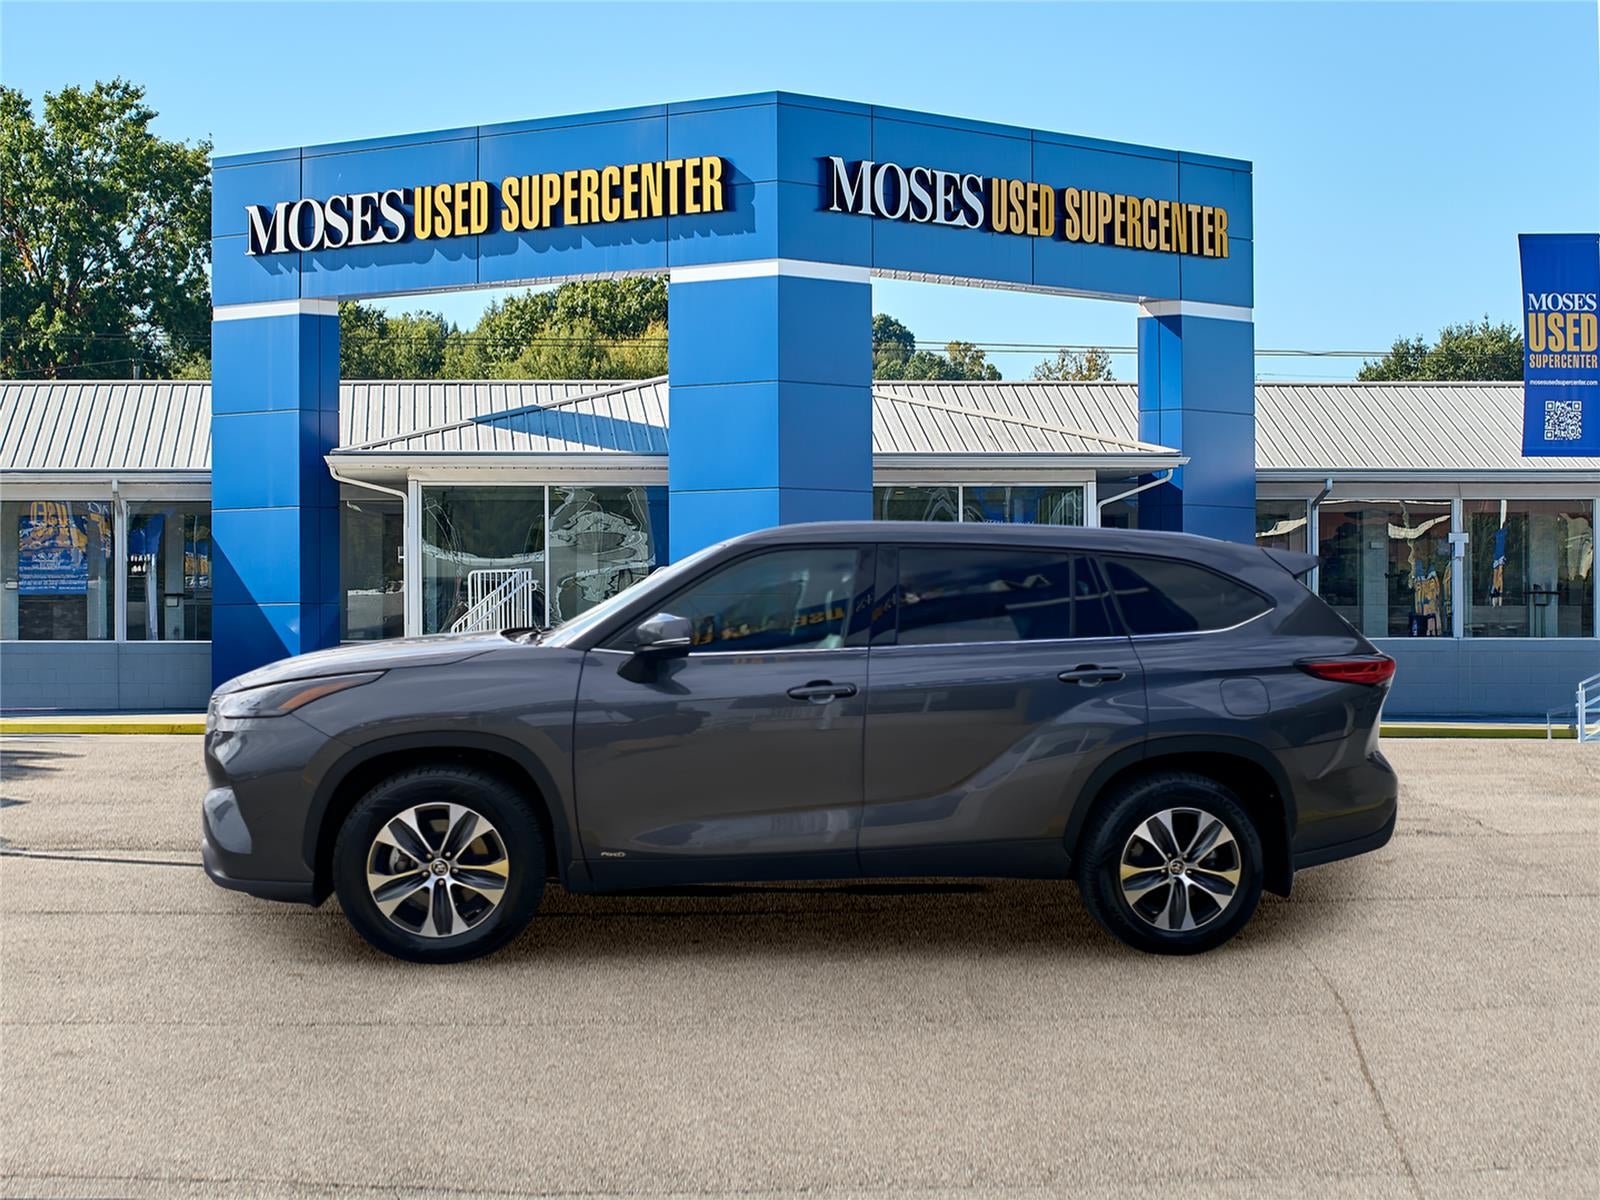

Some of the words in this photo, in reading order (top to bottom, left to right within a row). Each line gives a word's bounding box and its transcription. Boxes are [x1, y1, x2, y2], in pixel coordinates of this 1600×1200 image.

[244, 188, 408, 257] MOSES
[412, 180, 489, 240] USED
[500, 155, 724, 233] SUPERCENTER
[828, 156, 985, 229] MOSES
[991, 178, 1055, 238] USED
[1065, 187, 1230, 258] SUPERCENTER
[1527, 293, 1597, 311] MOSES
[1528, 312, 1598, 352] USED
[1529, 354, 1598, 369] SUPERCENTER
